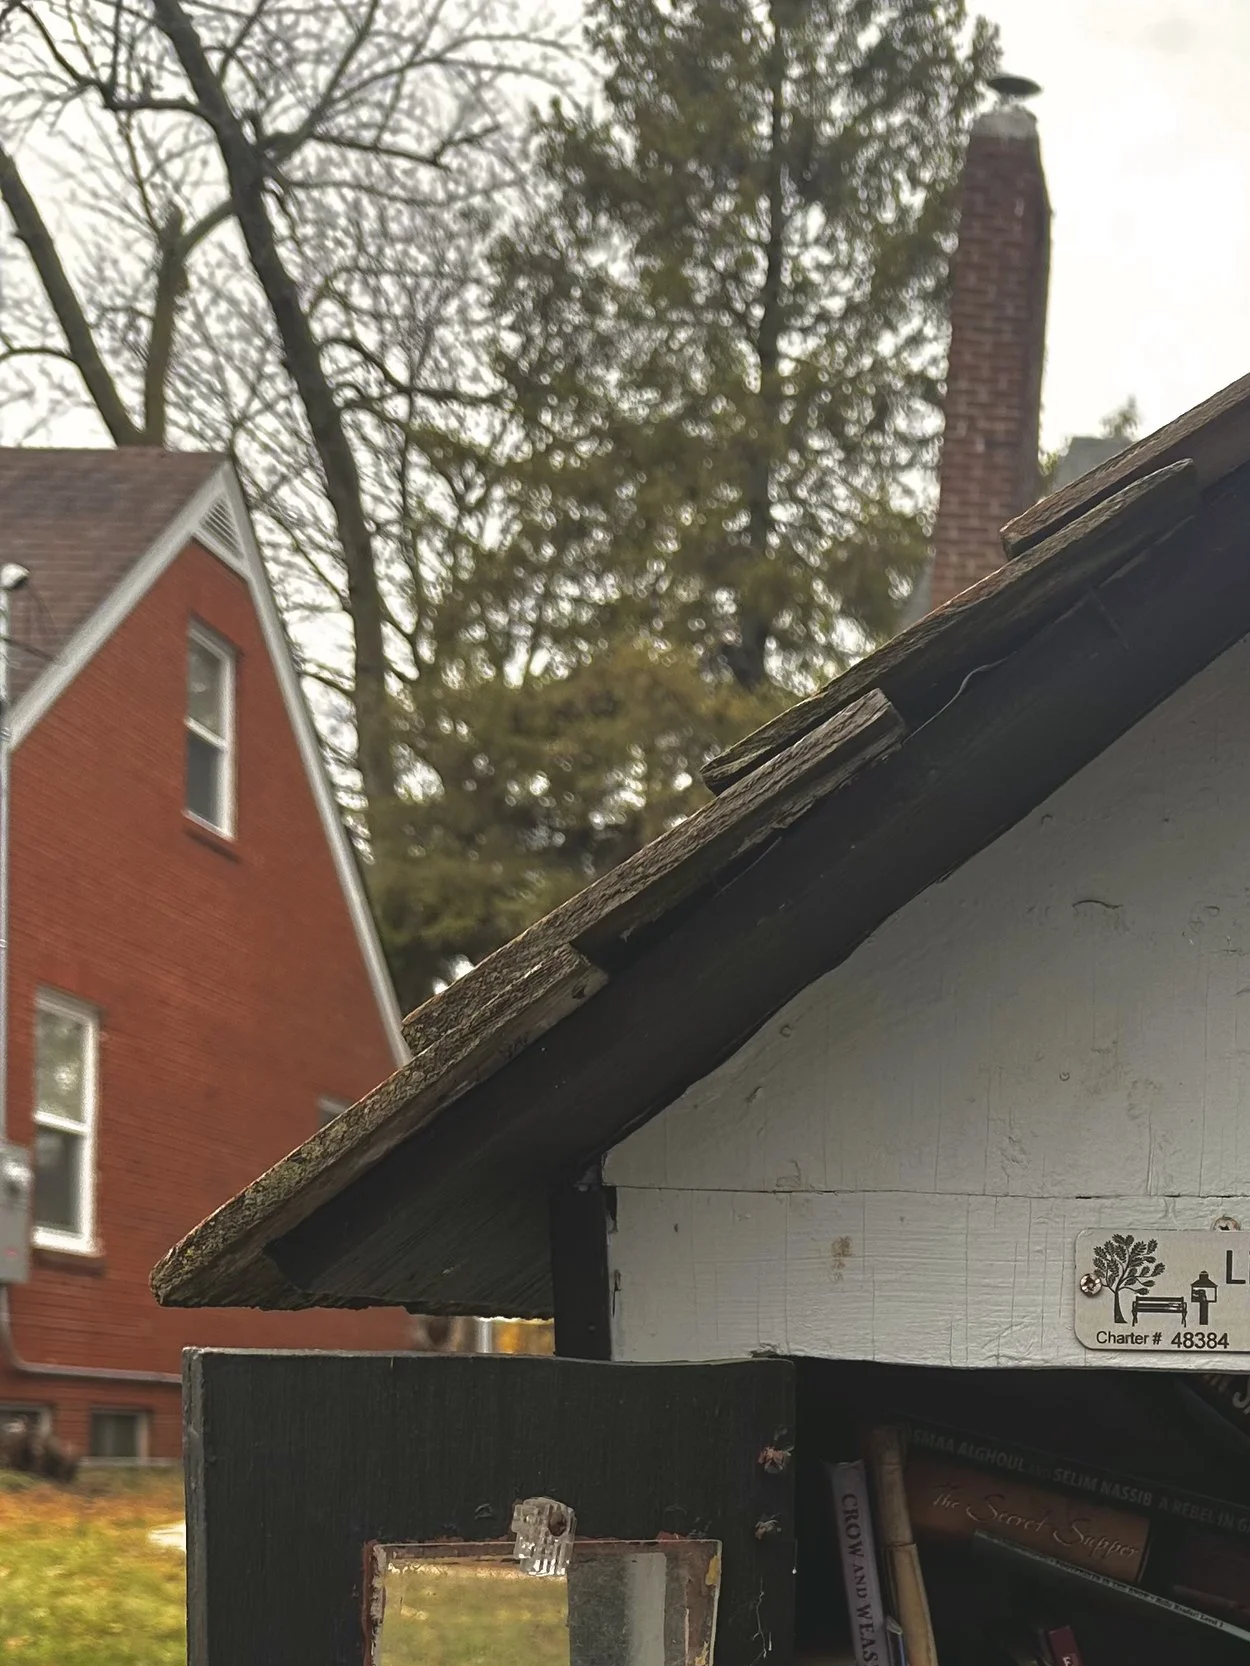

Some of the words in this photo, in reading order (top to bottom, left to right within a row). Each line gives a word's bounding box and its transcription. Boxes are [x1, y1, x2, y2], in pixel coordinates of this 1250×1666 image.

[1095, 1330, 1150, 1346] Charter
[1151, 1330, 1163, 1345] #
[1169, 1331, 1230, 1349] 48384
[840, 1492, 865, 1559] CROW
[1051, 1515, 1142, 1560] Supper
[851, 1562, 869, 1603] AND
